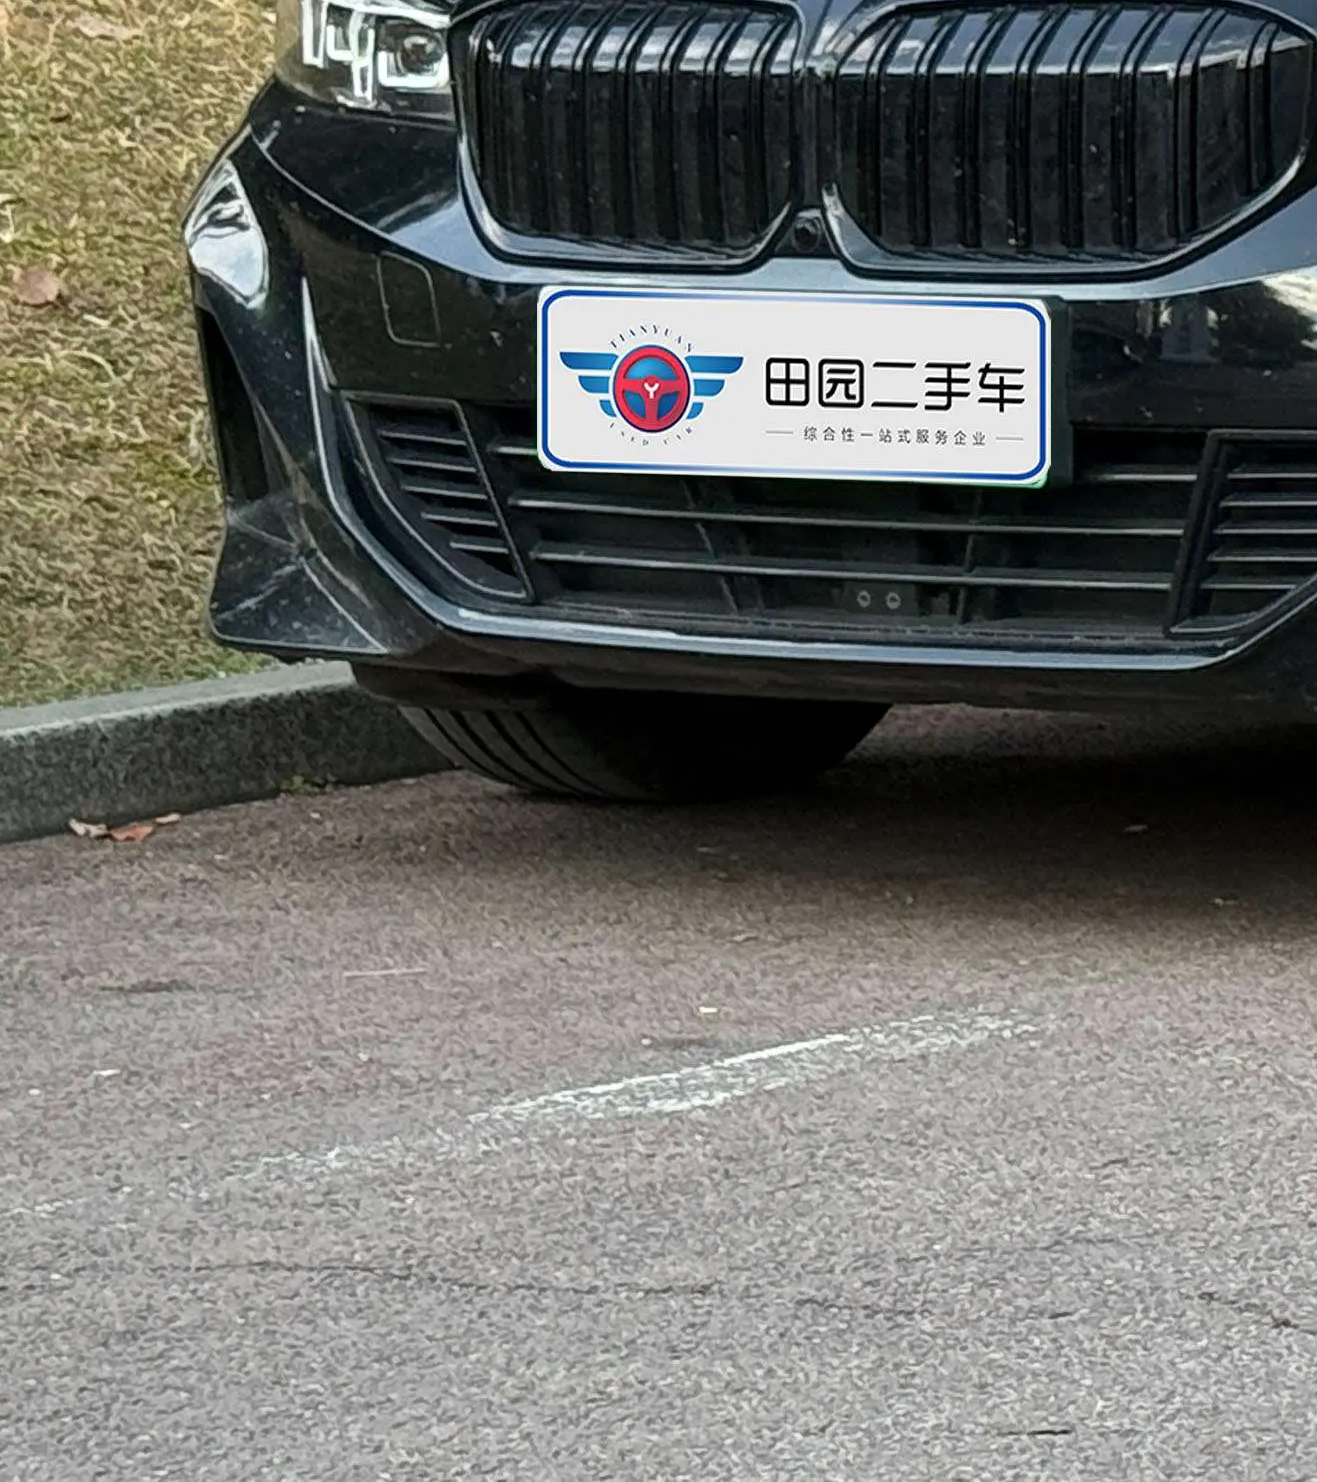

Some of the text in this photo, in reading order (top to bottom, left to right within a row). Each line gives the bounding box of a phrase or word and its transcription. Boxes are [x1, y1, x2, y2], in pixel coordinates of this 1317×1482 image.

[644, 382, 660, 399] Y
[765, 356, 1027, 413] 田园二手车
[802, 425, 988, 447] 综合性一站式服务企业
